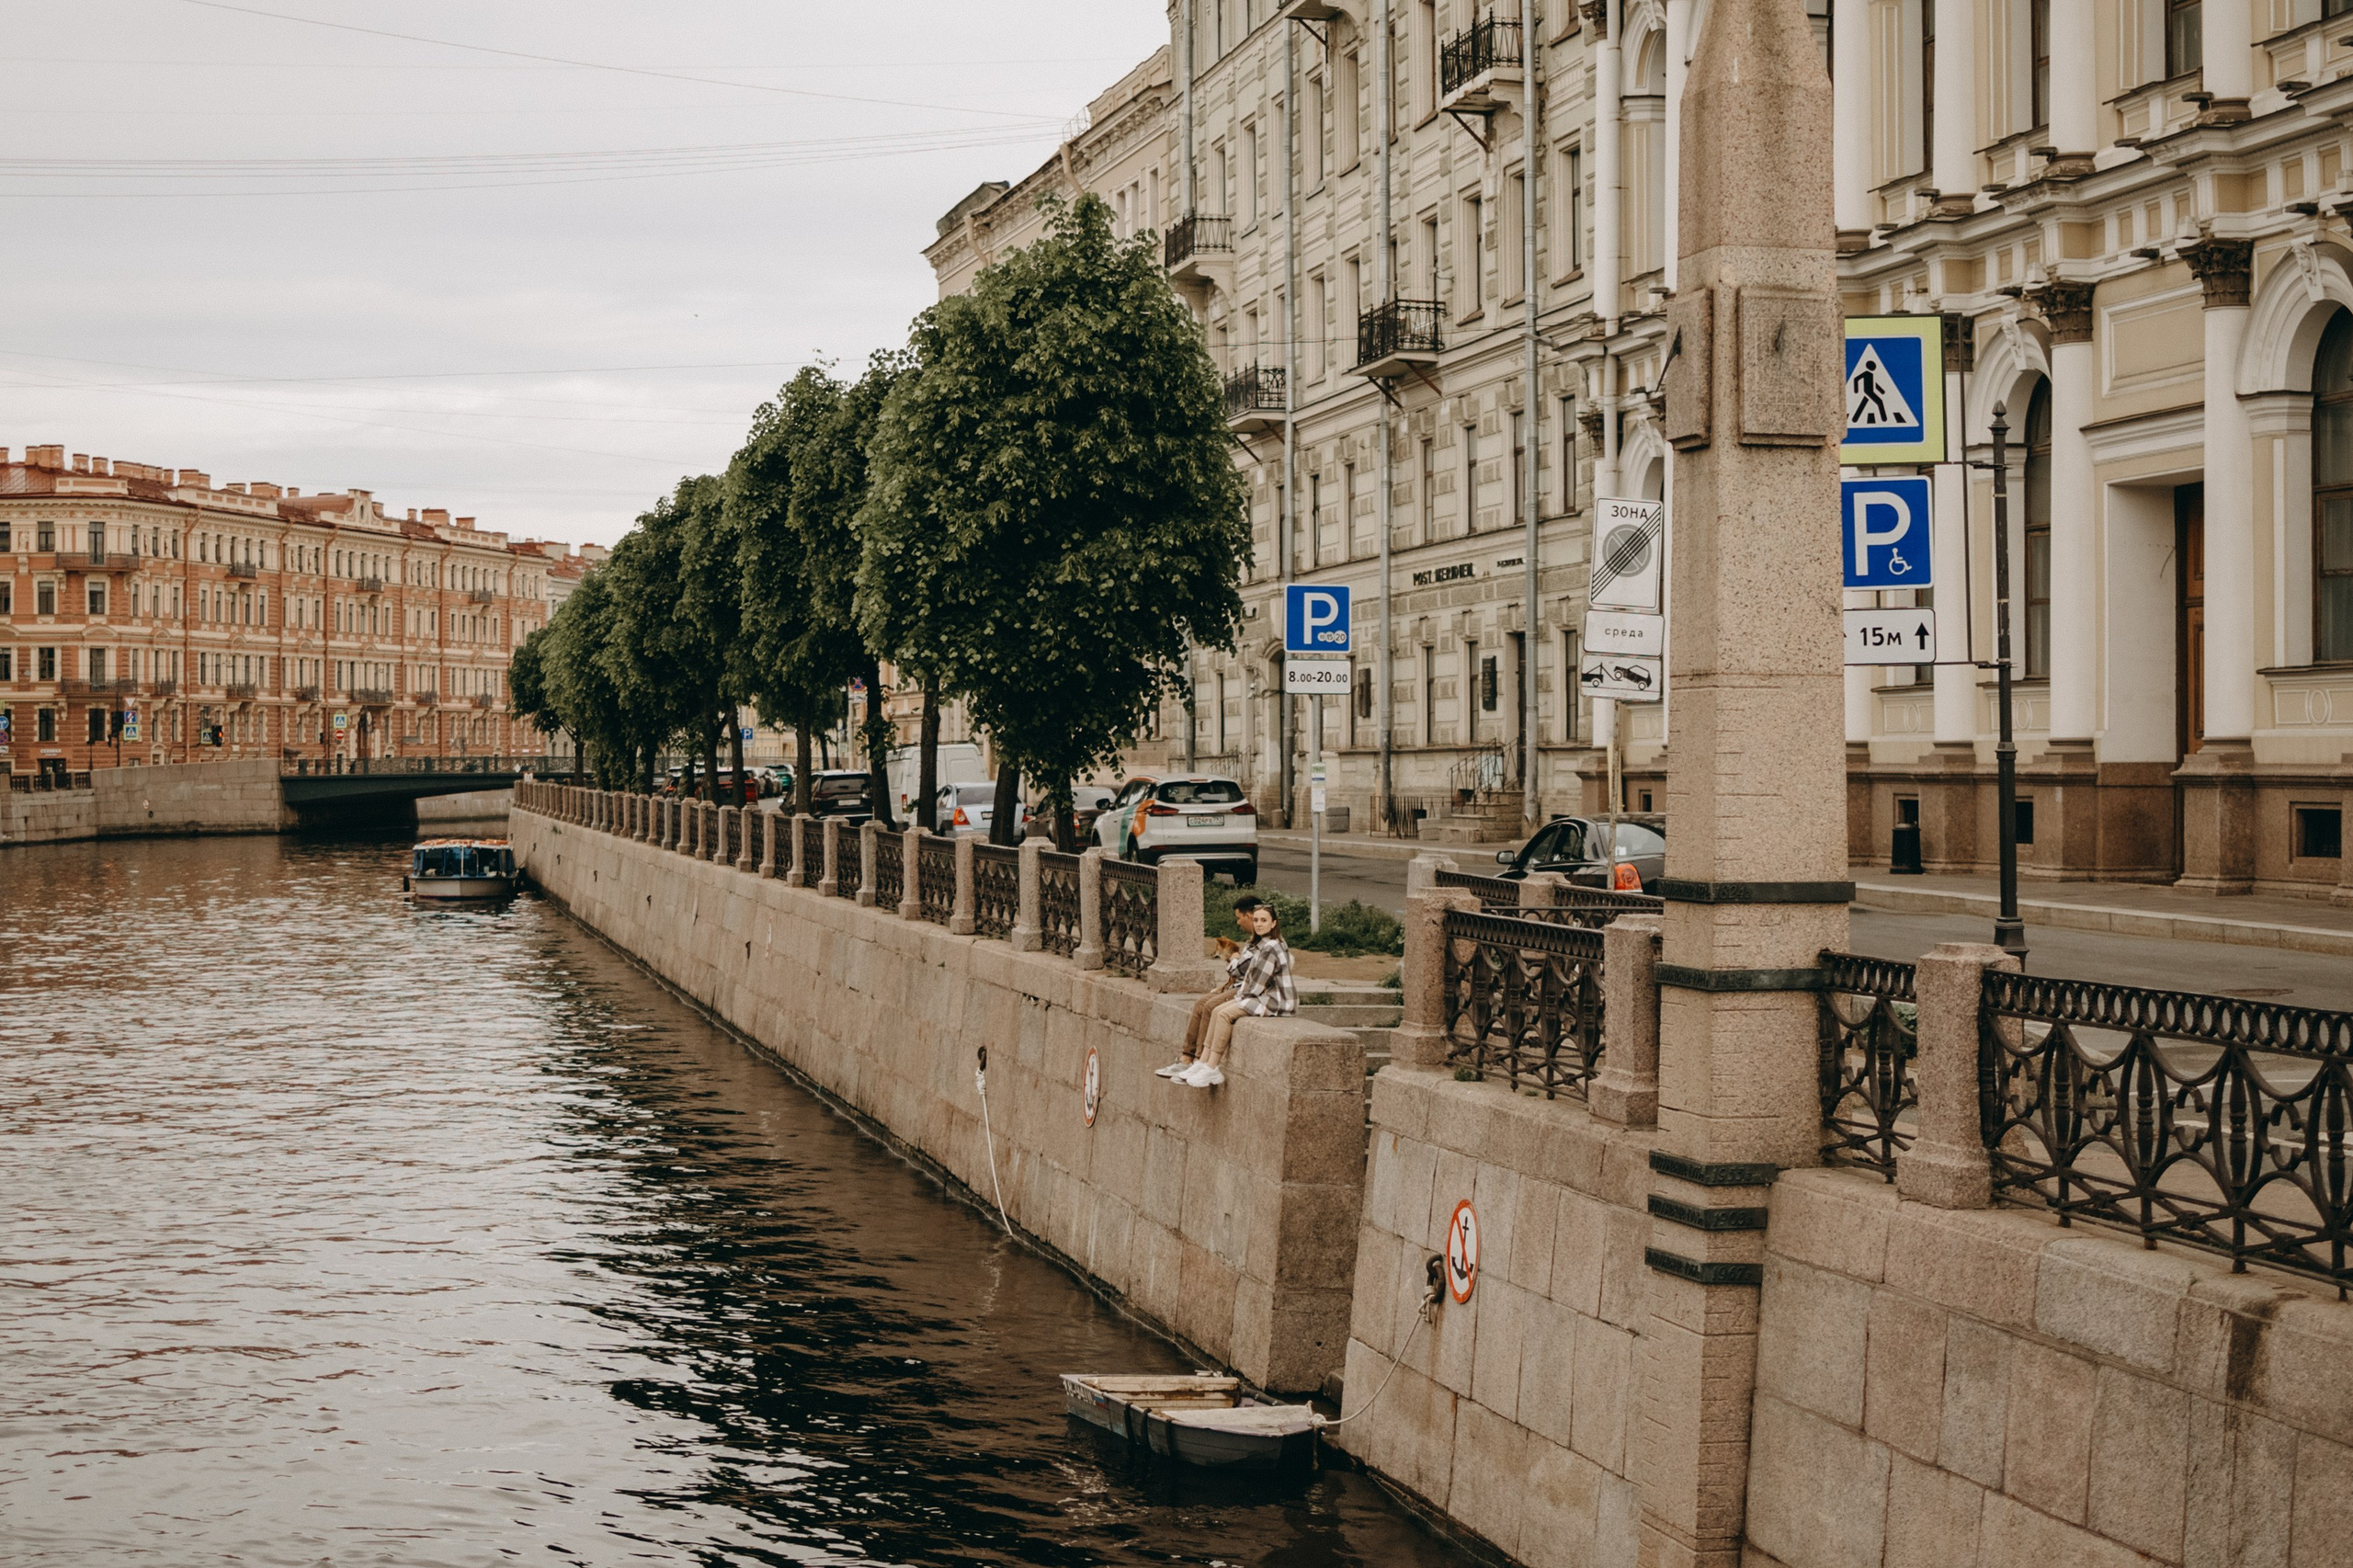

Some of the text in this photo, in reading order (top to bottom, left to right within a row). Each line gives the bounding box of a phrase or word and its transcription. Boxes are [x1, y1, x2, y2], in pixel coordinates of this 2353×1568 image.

[1611, 506, 1648, 520] ЗОНА
[1853, 491, 1911, 576] P
[1303, 592, 1339, 645] P
[1336, 633, 1346, 642] 20
[1605, 628, 1643, 638] среда
[1859, 627, 1902, 646] 15м
[1289, 671, 1347, 683] 8.00-20.00
[744, 729, 752, 739] P
